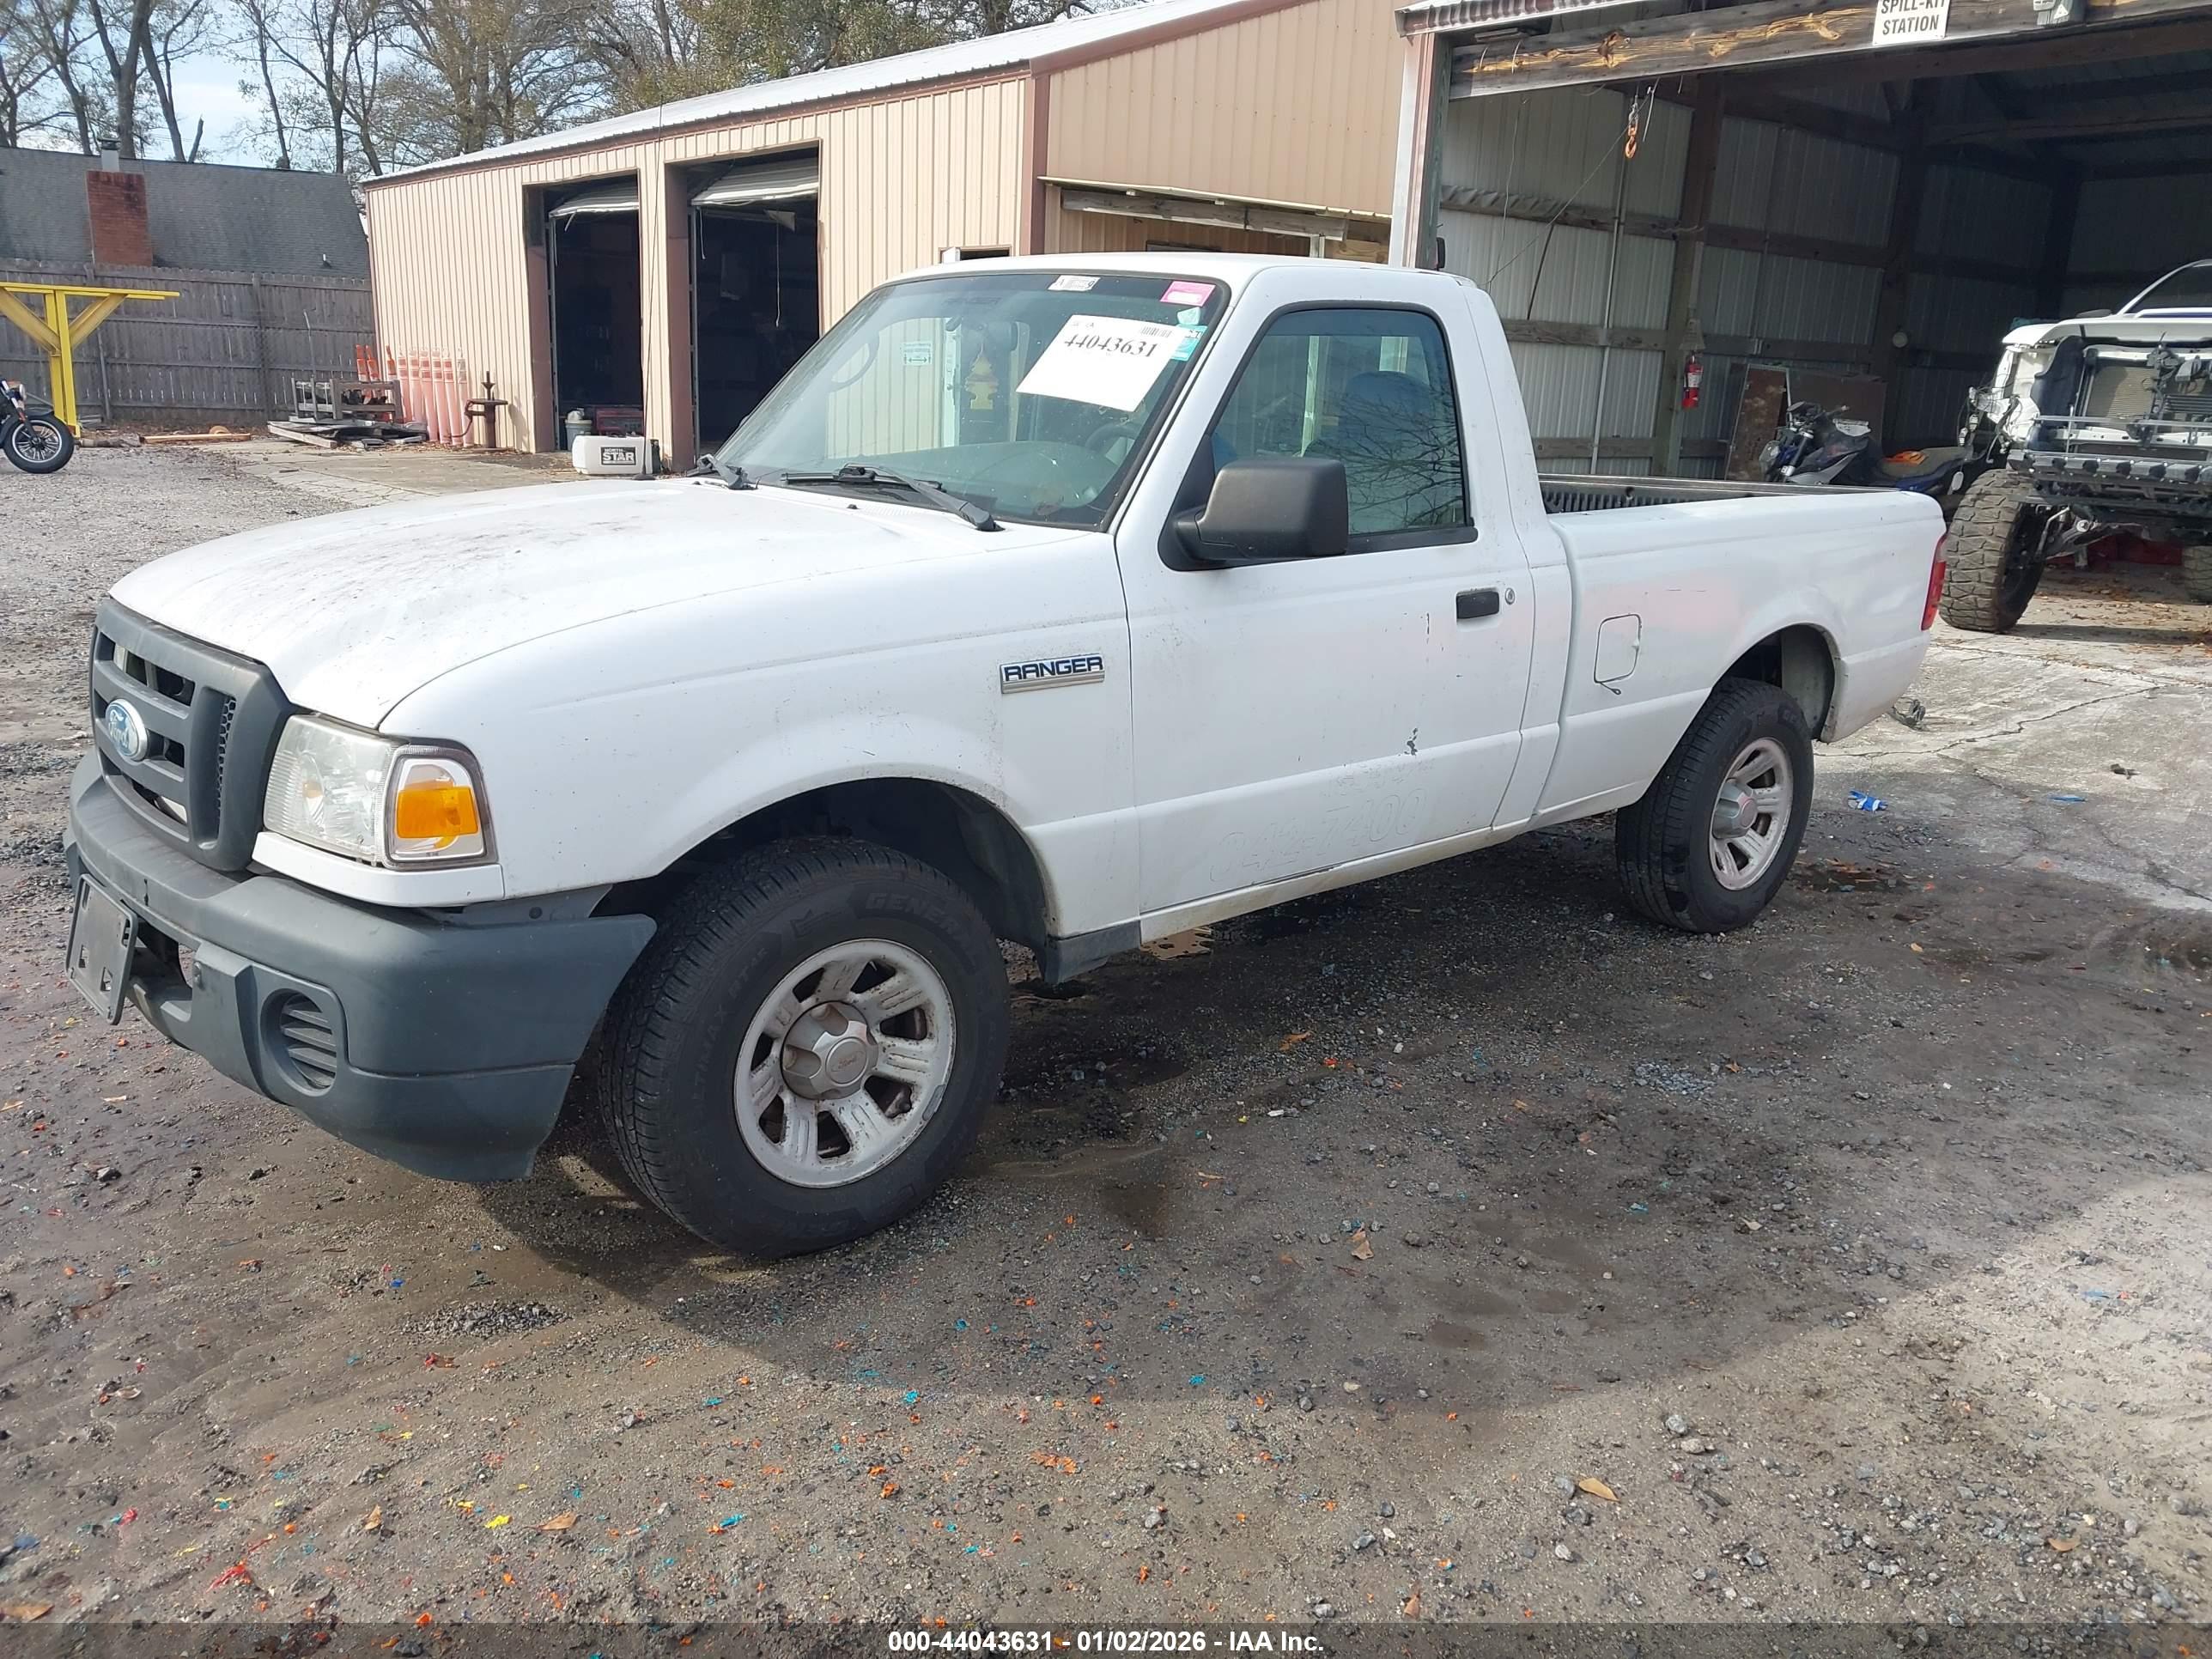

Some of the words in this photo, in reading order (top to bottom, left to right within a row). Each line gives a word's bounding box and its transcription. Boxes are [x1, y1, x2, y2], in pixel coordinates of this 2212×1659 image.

[1882, 14, 1939, 35] STATION
[1064, 333, 1158, 358] 44043631
[603, 452, 635, 461] STAR
[1004, 656, 1103, 682] RANGER
